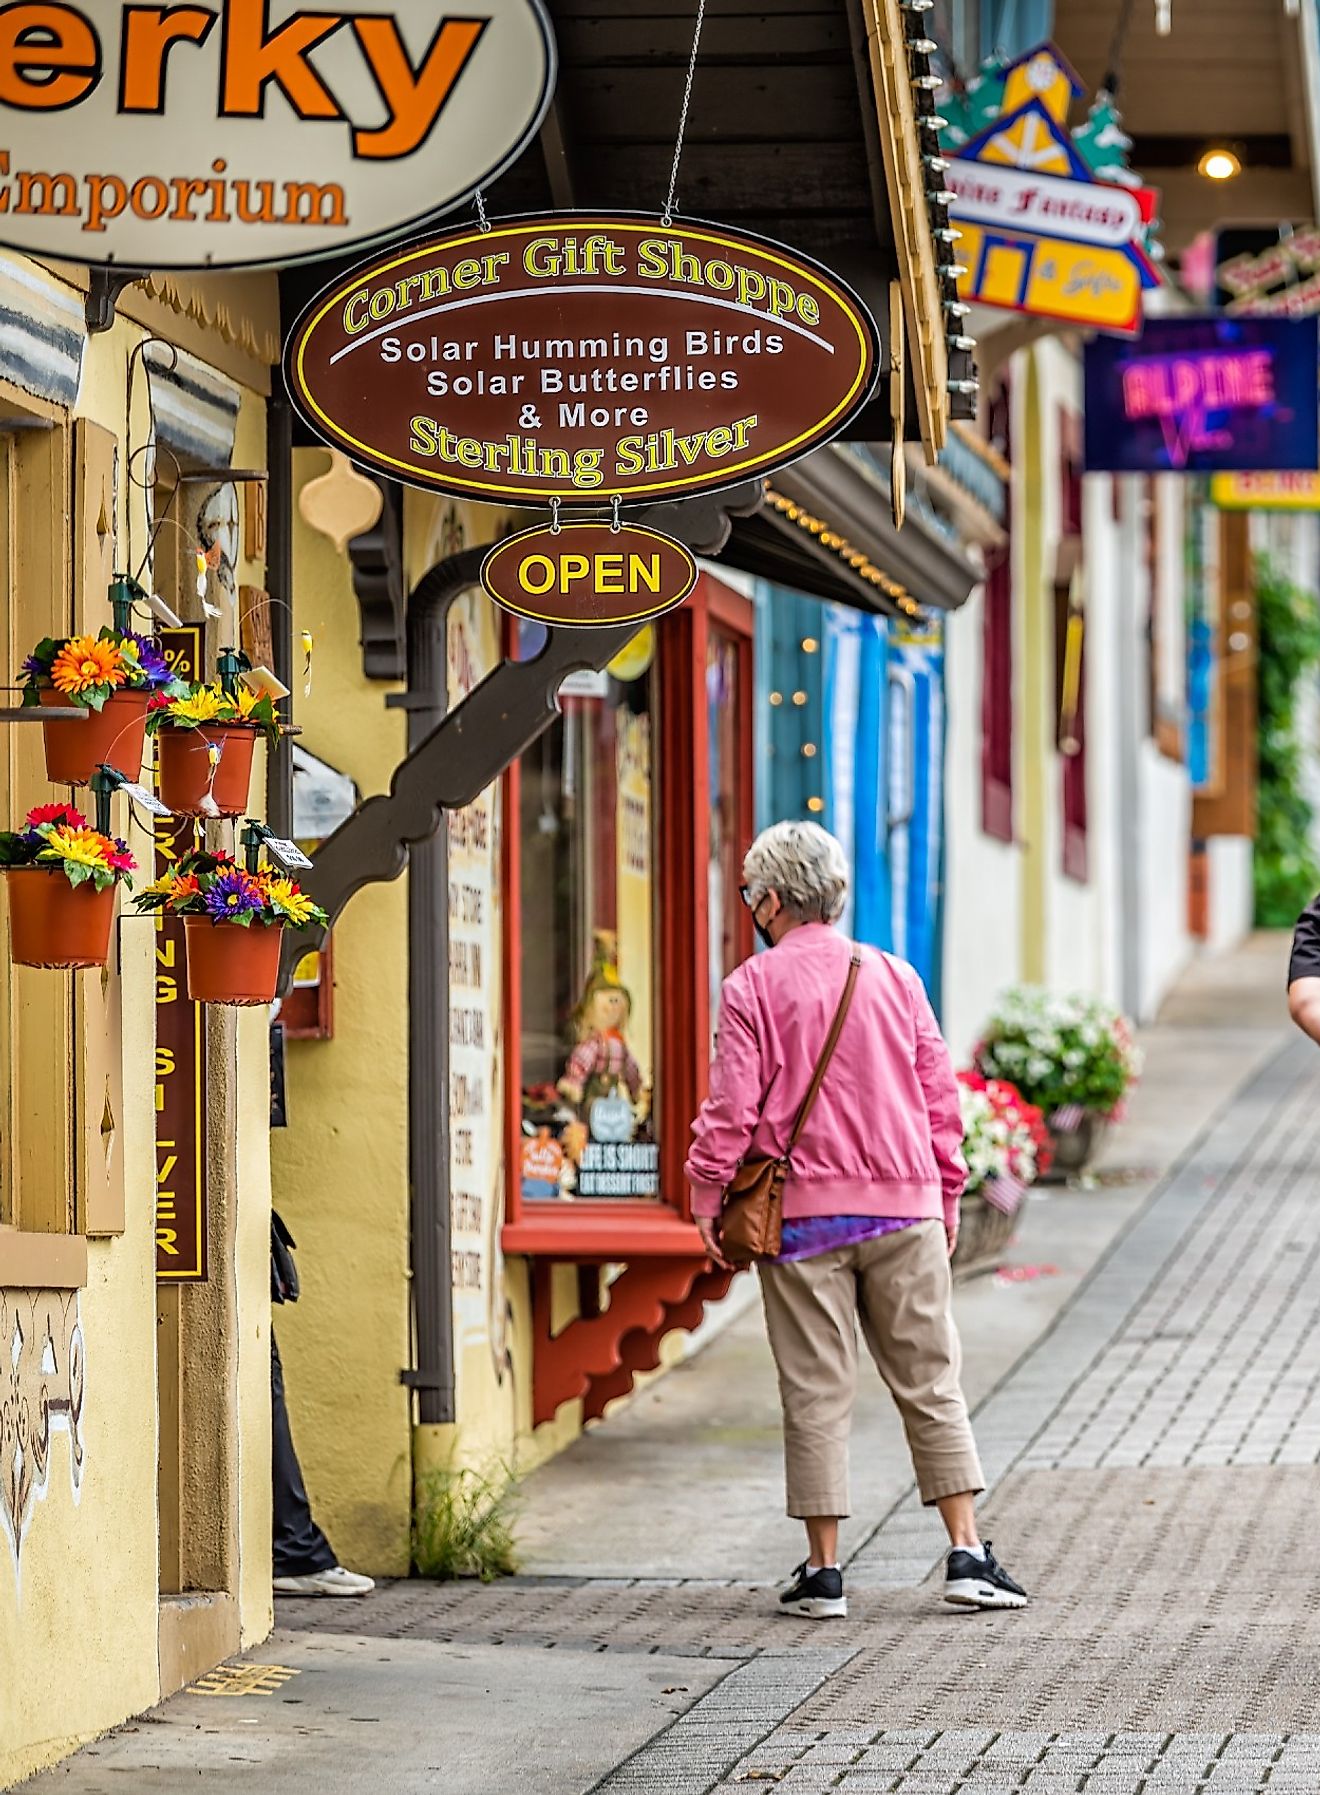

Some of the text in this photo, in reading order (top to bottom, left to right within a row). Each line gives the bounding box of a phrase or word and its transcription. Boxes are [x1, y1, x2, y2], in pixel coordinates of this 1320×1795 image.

[0, 0, 493, 162] erky
[1009, 186, 1126, 231] Fantasy
[343, 236, 820, 335] Corner Gift Shoppe
[380, 329, 784, 363] Solar Humming Birds
[427, 365, 739, 396] Solar Butterflies
[1123, 350, 1275, 423] ALPINE
[518, 402, 649, 429] & More
[409, 414, 758, 488] Sterling Silver
[1234, 469, 1316, 494] BLING
[518, 554, 661, 595] OPEN
[617, 1143, 658, 1171] SHORT
